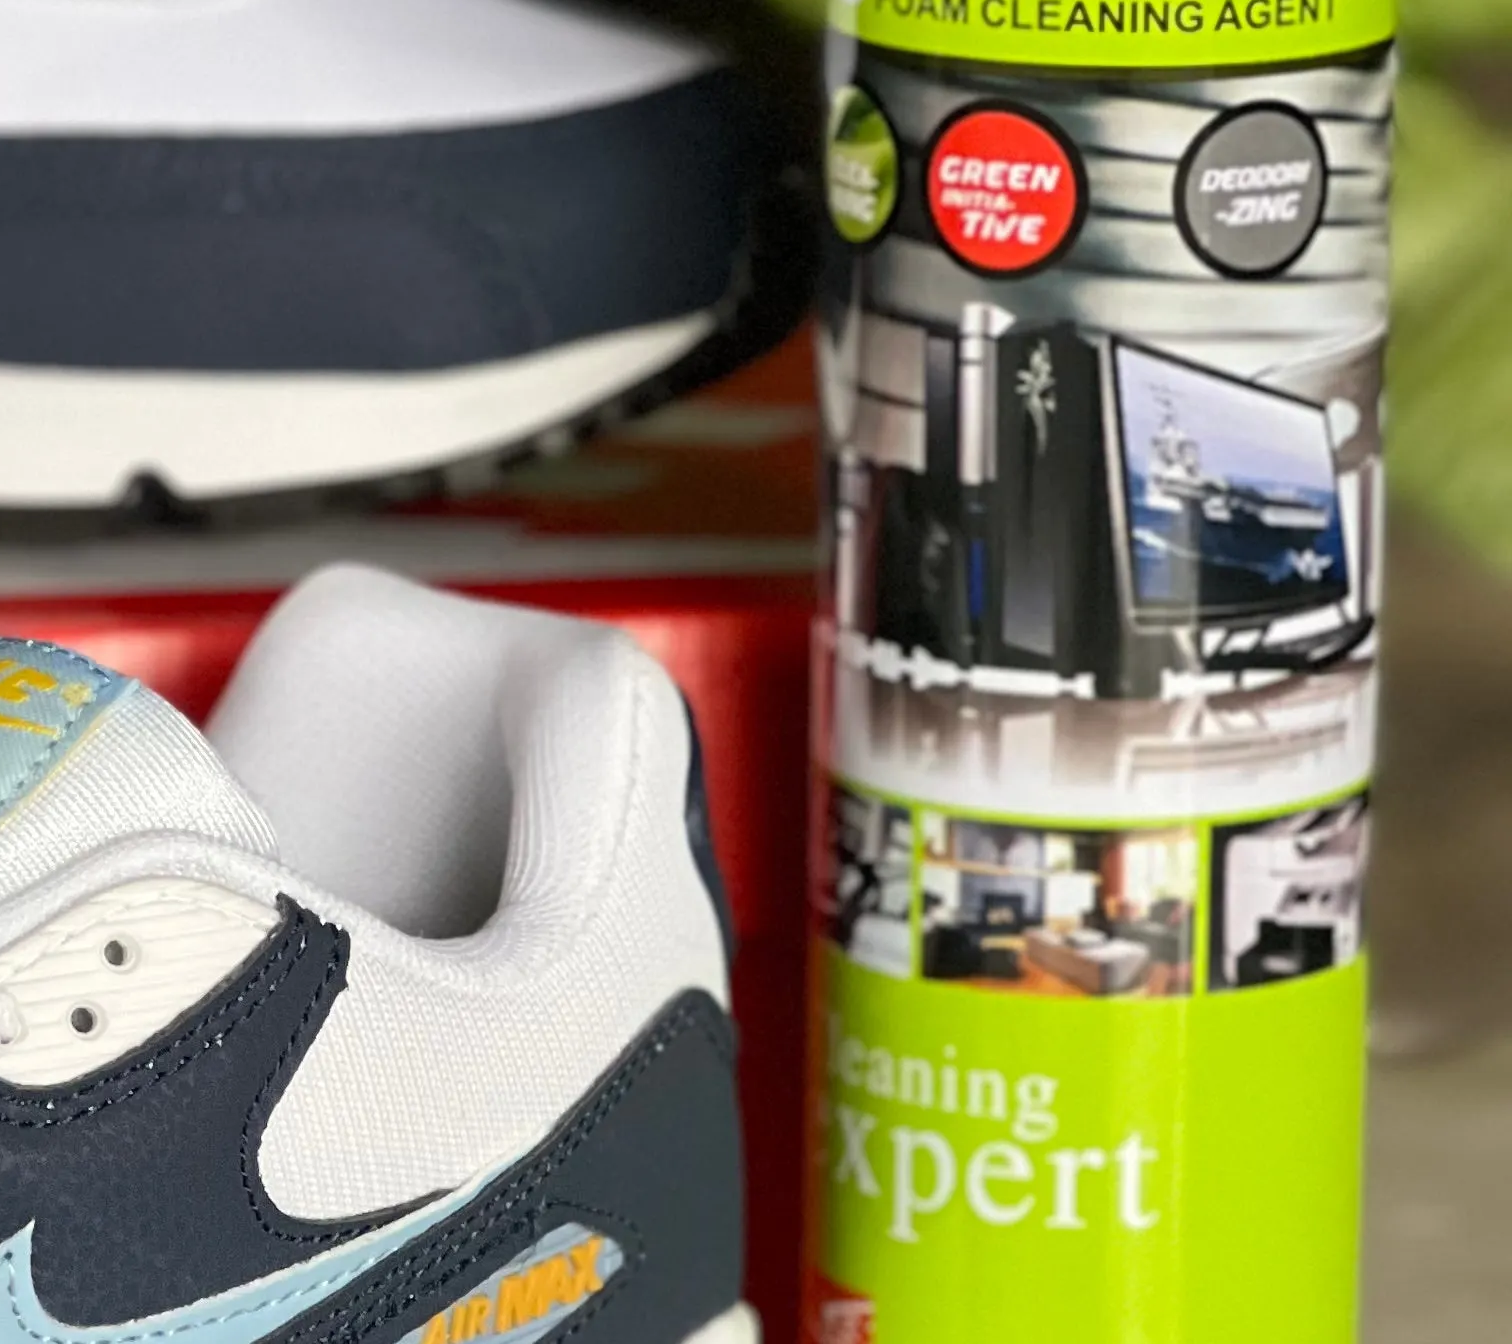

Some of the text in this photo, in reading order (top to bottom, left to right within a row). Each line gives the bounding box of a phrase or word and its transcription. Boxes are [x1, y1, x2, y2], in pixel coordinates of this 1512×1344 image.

[939, 155, 1061, 193] GREEN
[827, 1013, 1059, 1143] leaning
[836, 1103, 1160, 1244] xpert
[494, 1235, 604, 1335] MAX
